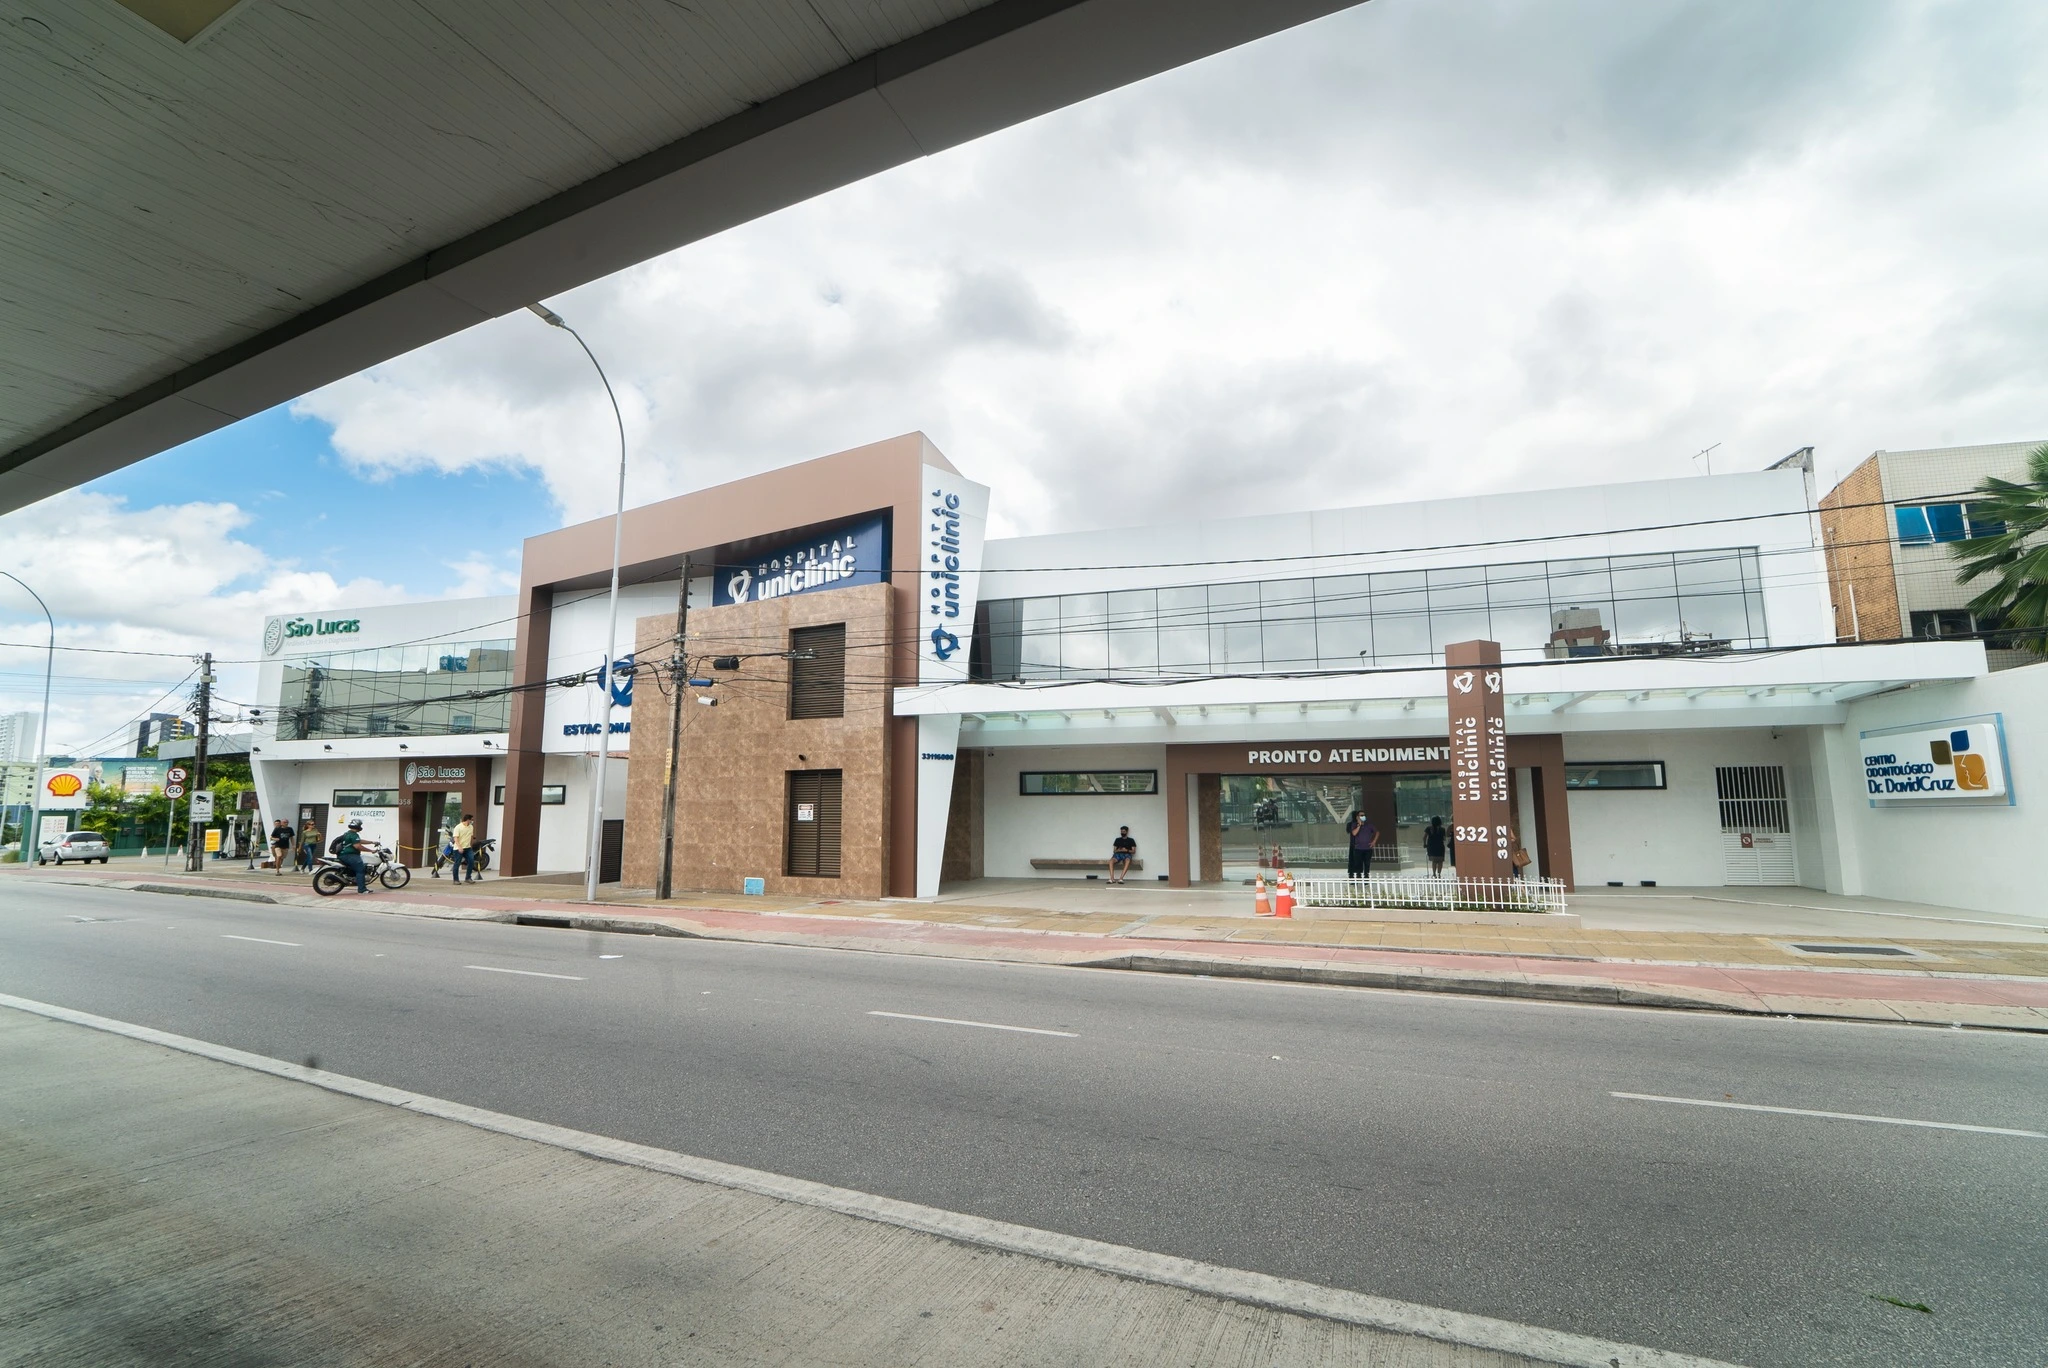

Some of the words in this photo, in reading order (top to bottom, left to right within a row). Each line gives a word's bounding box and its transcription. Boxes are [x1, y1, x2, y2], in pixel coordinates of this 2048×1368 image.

[758, 535, 856, 576] HOSPITAL
[931, 489, 941, 615] HOSPITAL
[941, 493, 960, 618] uniclinic
[757, 552, 856, 601] uniclinic
[284, 617, 313, 638] São
[316, 618, 360, 635] Lucas
[417, 765, 436, 778] São
[437, 765, 466, 778] Lucas
[1248, 749, 1322, 764] PRONTO
[1455, 717, 1467, 801] HOSPITAL
[1463, 716, 1481, 801] uniclinic
[1488, 716, 1498, 801] HOSPITAL
[1494, 717, 1508, 801] uniclinic
[1864, 754, 1897, 767] CENTRO
[1866, 761, 1934, 778] ODONTOLÓGICO
[168, 786, 182, 794] 60
[1867, 779, 1884, 794] Dr.
[1455, 825, 1488, 843] 332
[1496, 825, 1508, 859] 332
